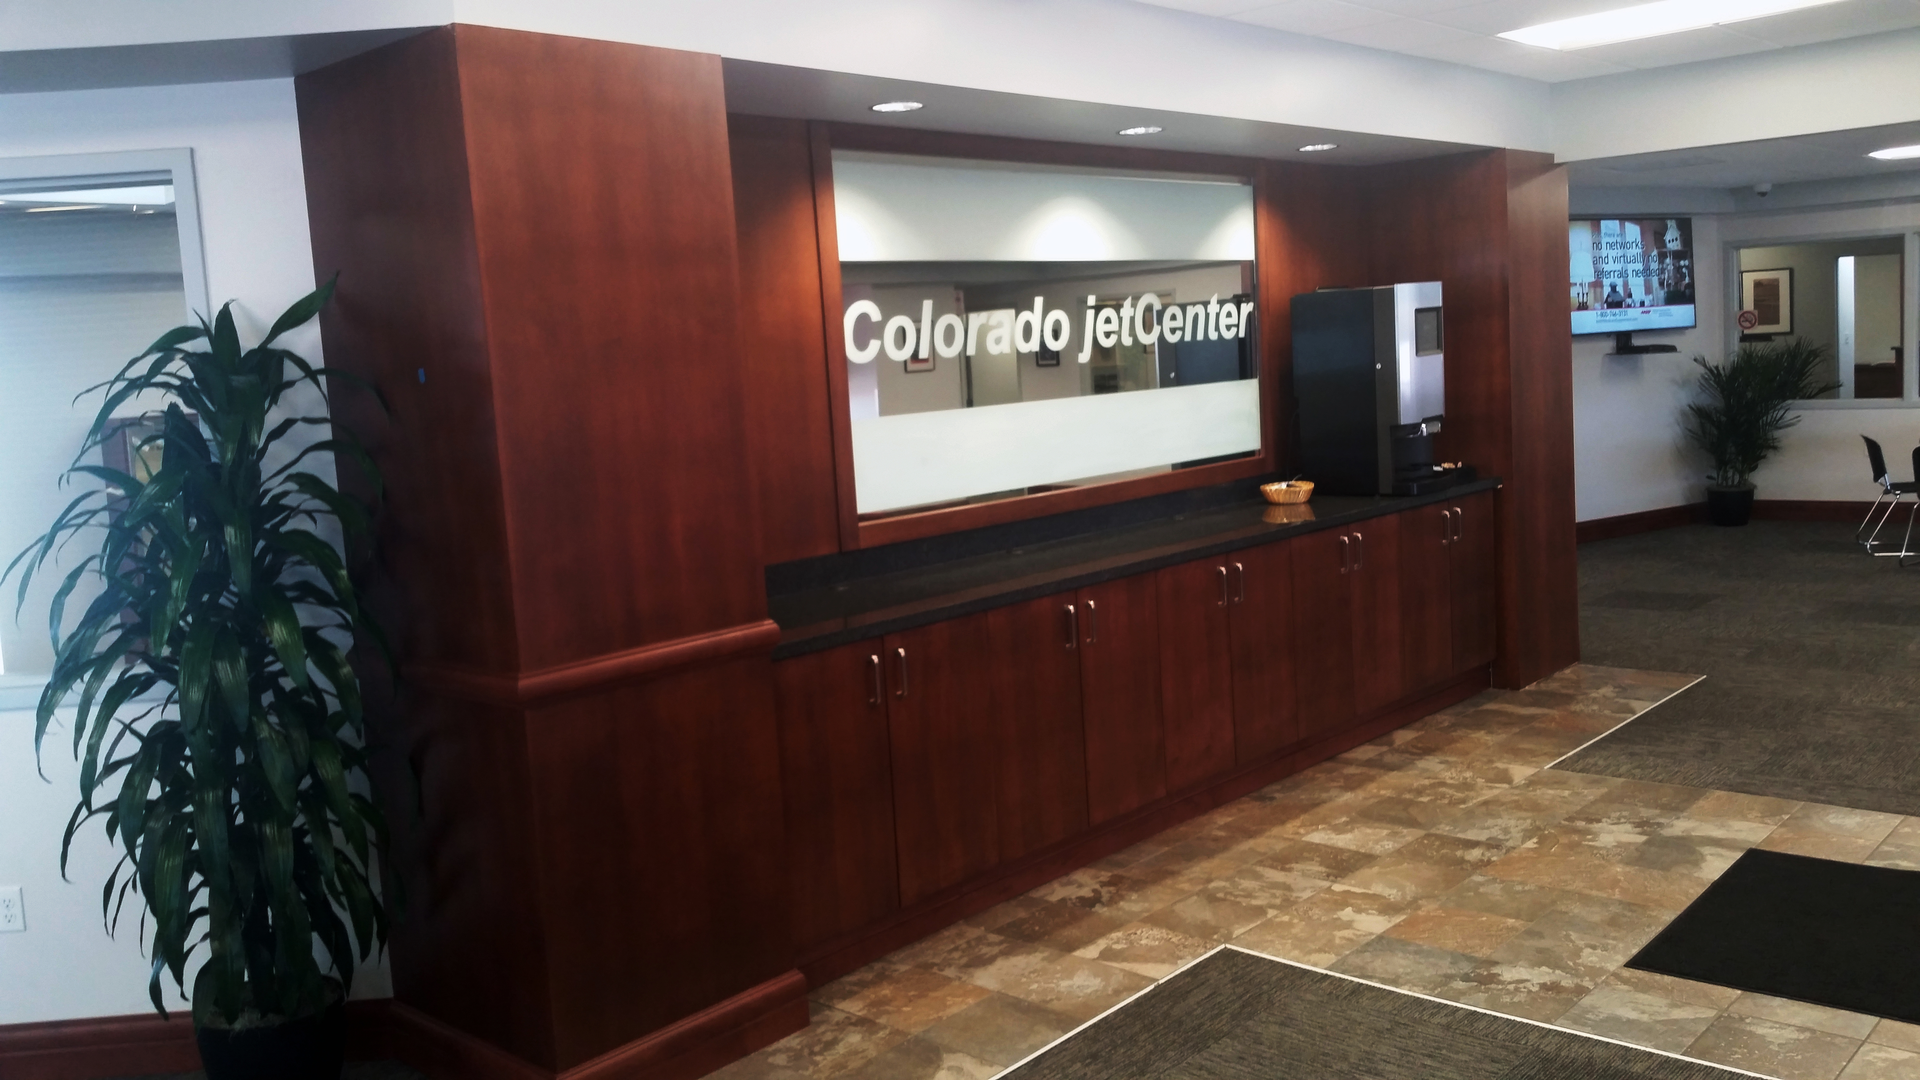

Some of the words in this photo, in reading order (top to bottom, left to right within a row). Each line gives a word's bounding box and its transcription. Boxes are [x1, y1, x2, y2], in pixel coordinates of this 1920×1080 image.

[1592, 241, 1603, 251] no
[1605, 238, 1646, 251] networks
[1592, 253, 1609, 265] and
[1612, 252, 1646, 267] virtually
[1647, 254, 1658, 264] no
[1593, 267, 1629, 280] referrals
[843, 296, 1070, 364] Colorado
[1078, 292, 1253, 363] jetCenter
